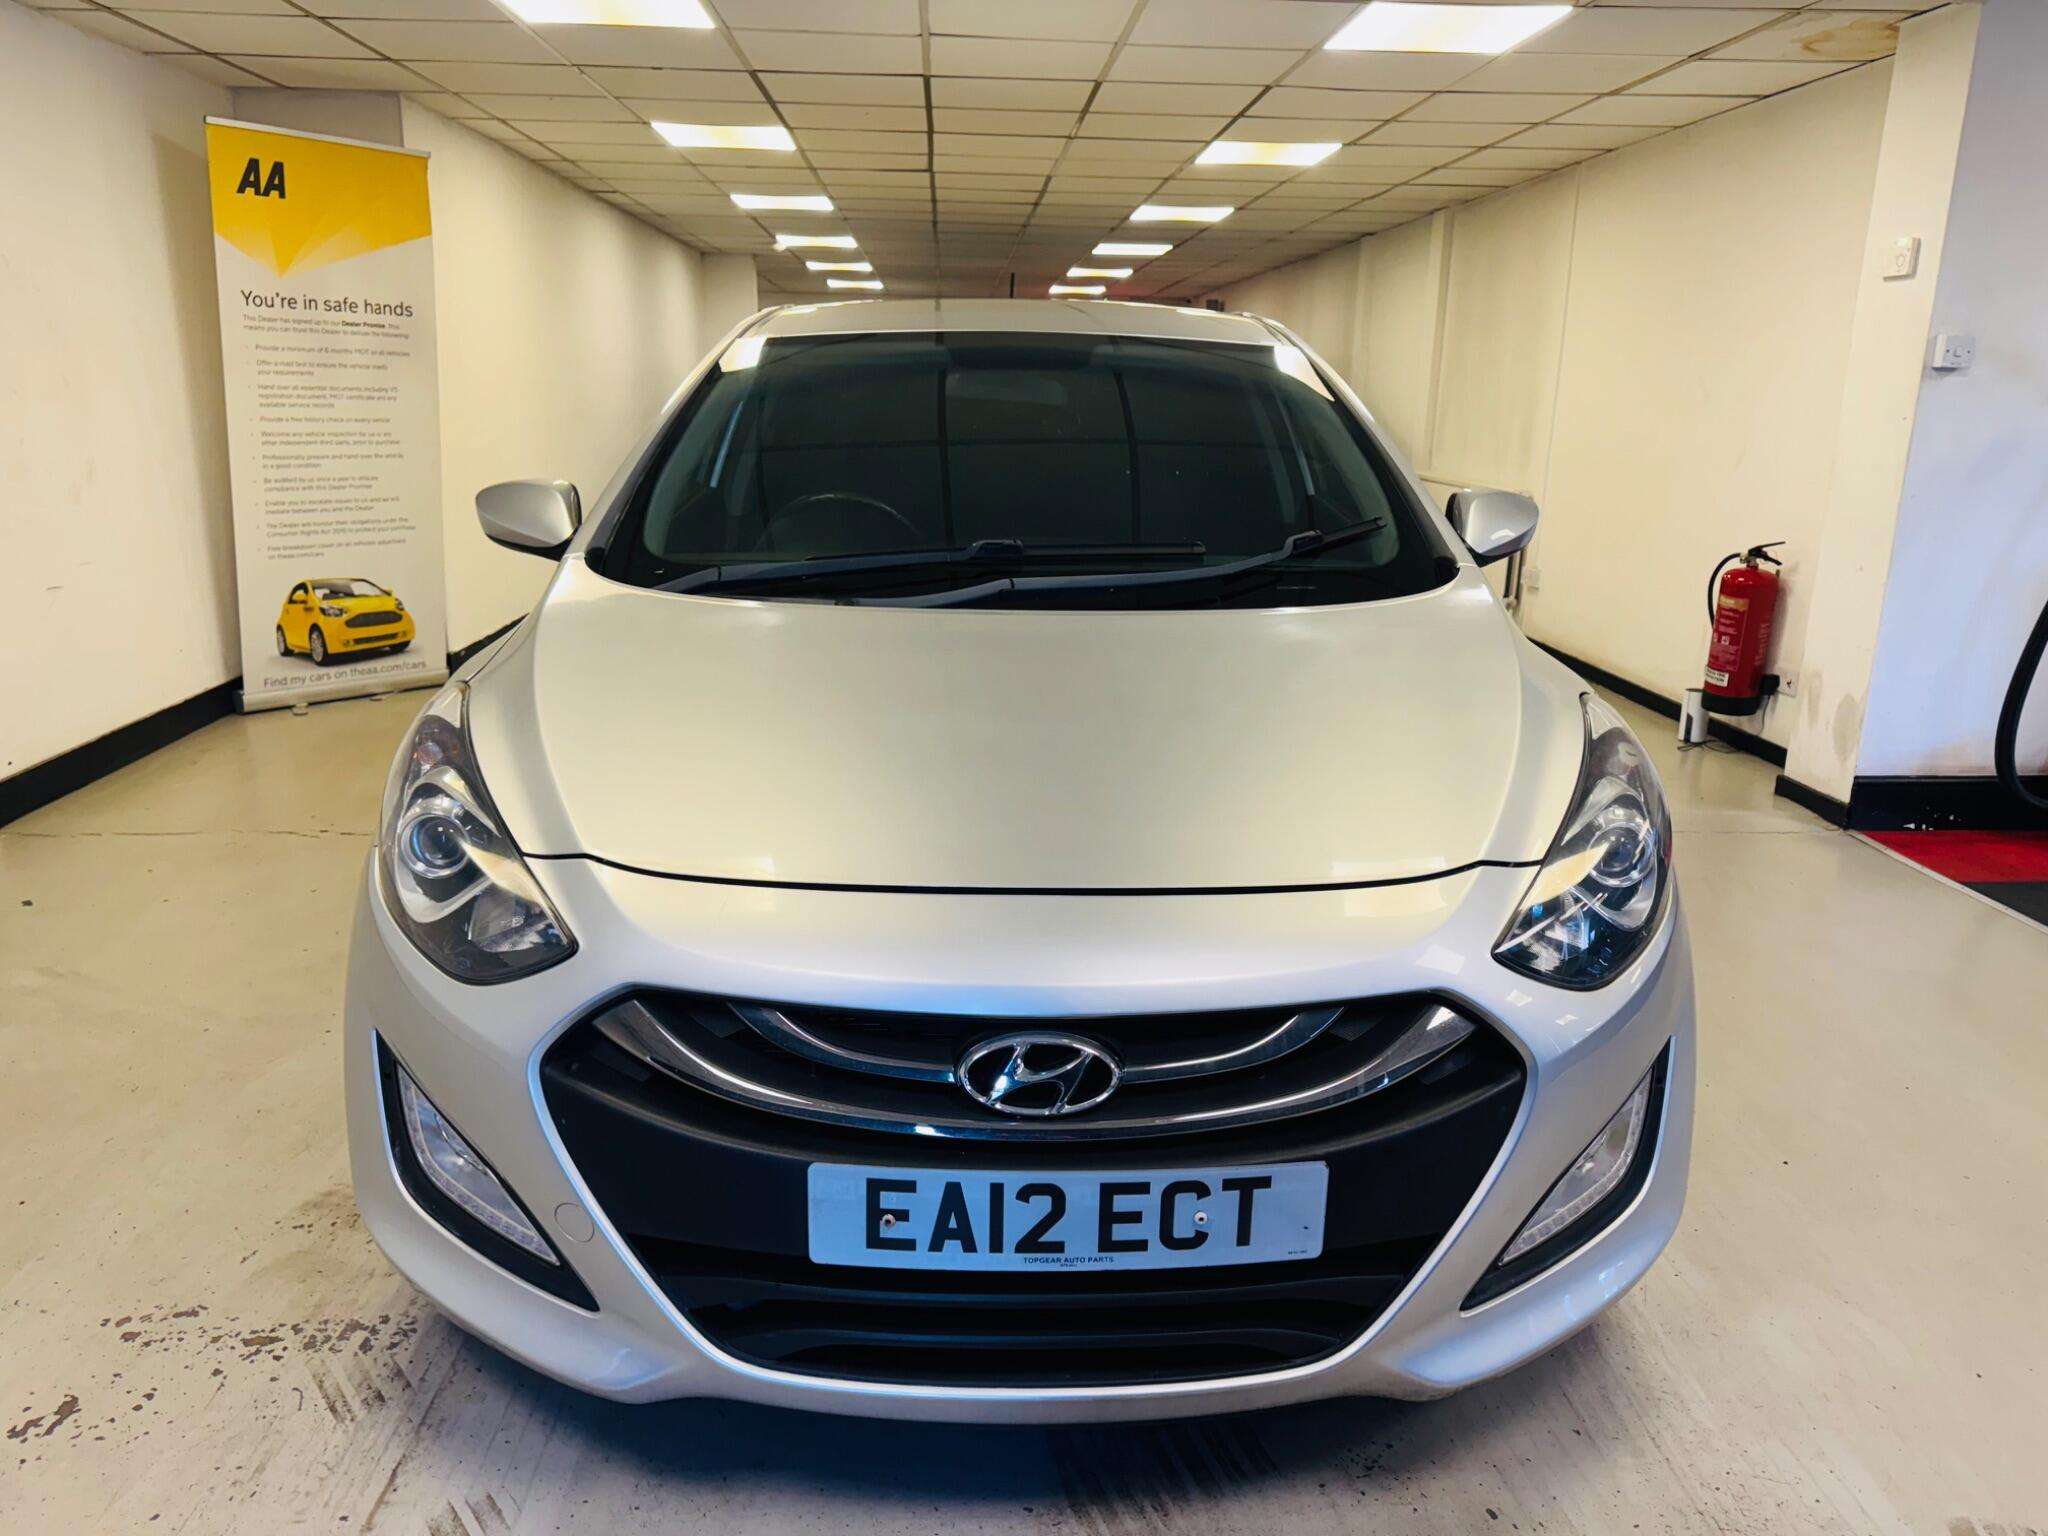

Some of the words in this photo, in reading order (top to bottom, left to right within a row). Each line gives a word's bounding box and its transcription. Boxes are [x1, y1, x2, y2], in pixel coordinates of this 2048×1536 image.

[236, 157, 287, 199] AA
[241, 289, 298, 310] You're
[303, 294, 318, 311] in
[324, 297, 358, 314] safe
[364, 299, 414, 317] hands
[264, 676, 288, 688] Find
[290, 673, 307, 688] my
[309, 670, 332, 681] cars
[335, 668, 347, 678] on
[350, 657, 427, 677] theaa.com/cars
[866, 1177, 1067, 1255] EA12
[1097, 1176, 1272, 1254] ECT
[1023, 1256, 1062, 1264] TOPGEAR
[1064, 1256, 1085, 1264] AUTO
[1087, 1256, 1114, 1264] PARTS
